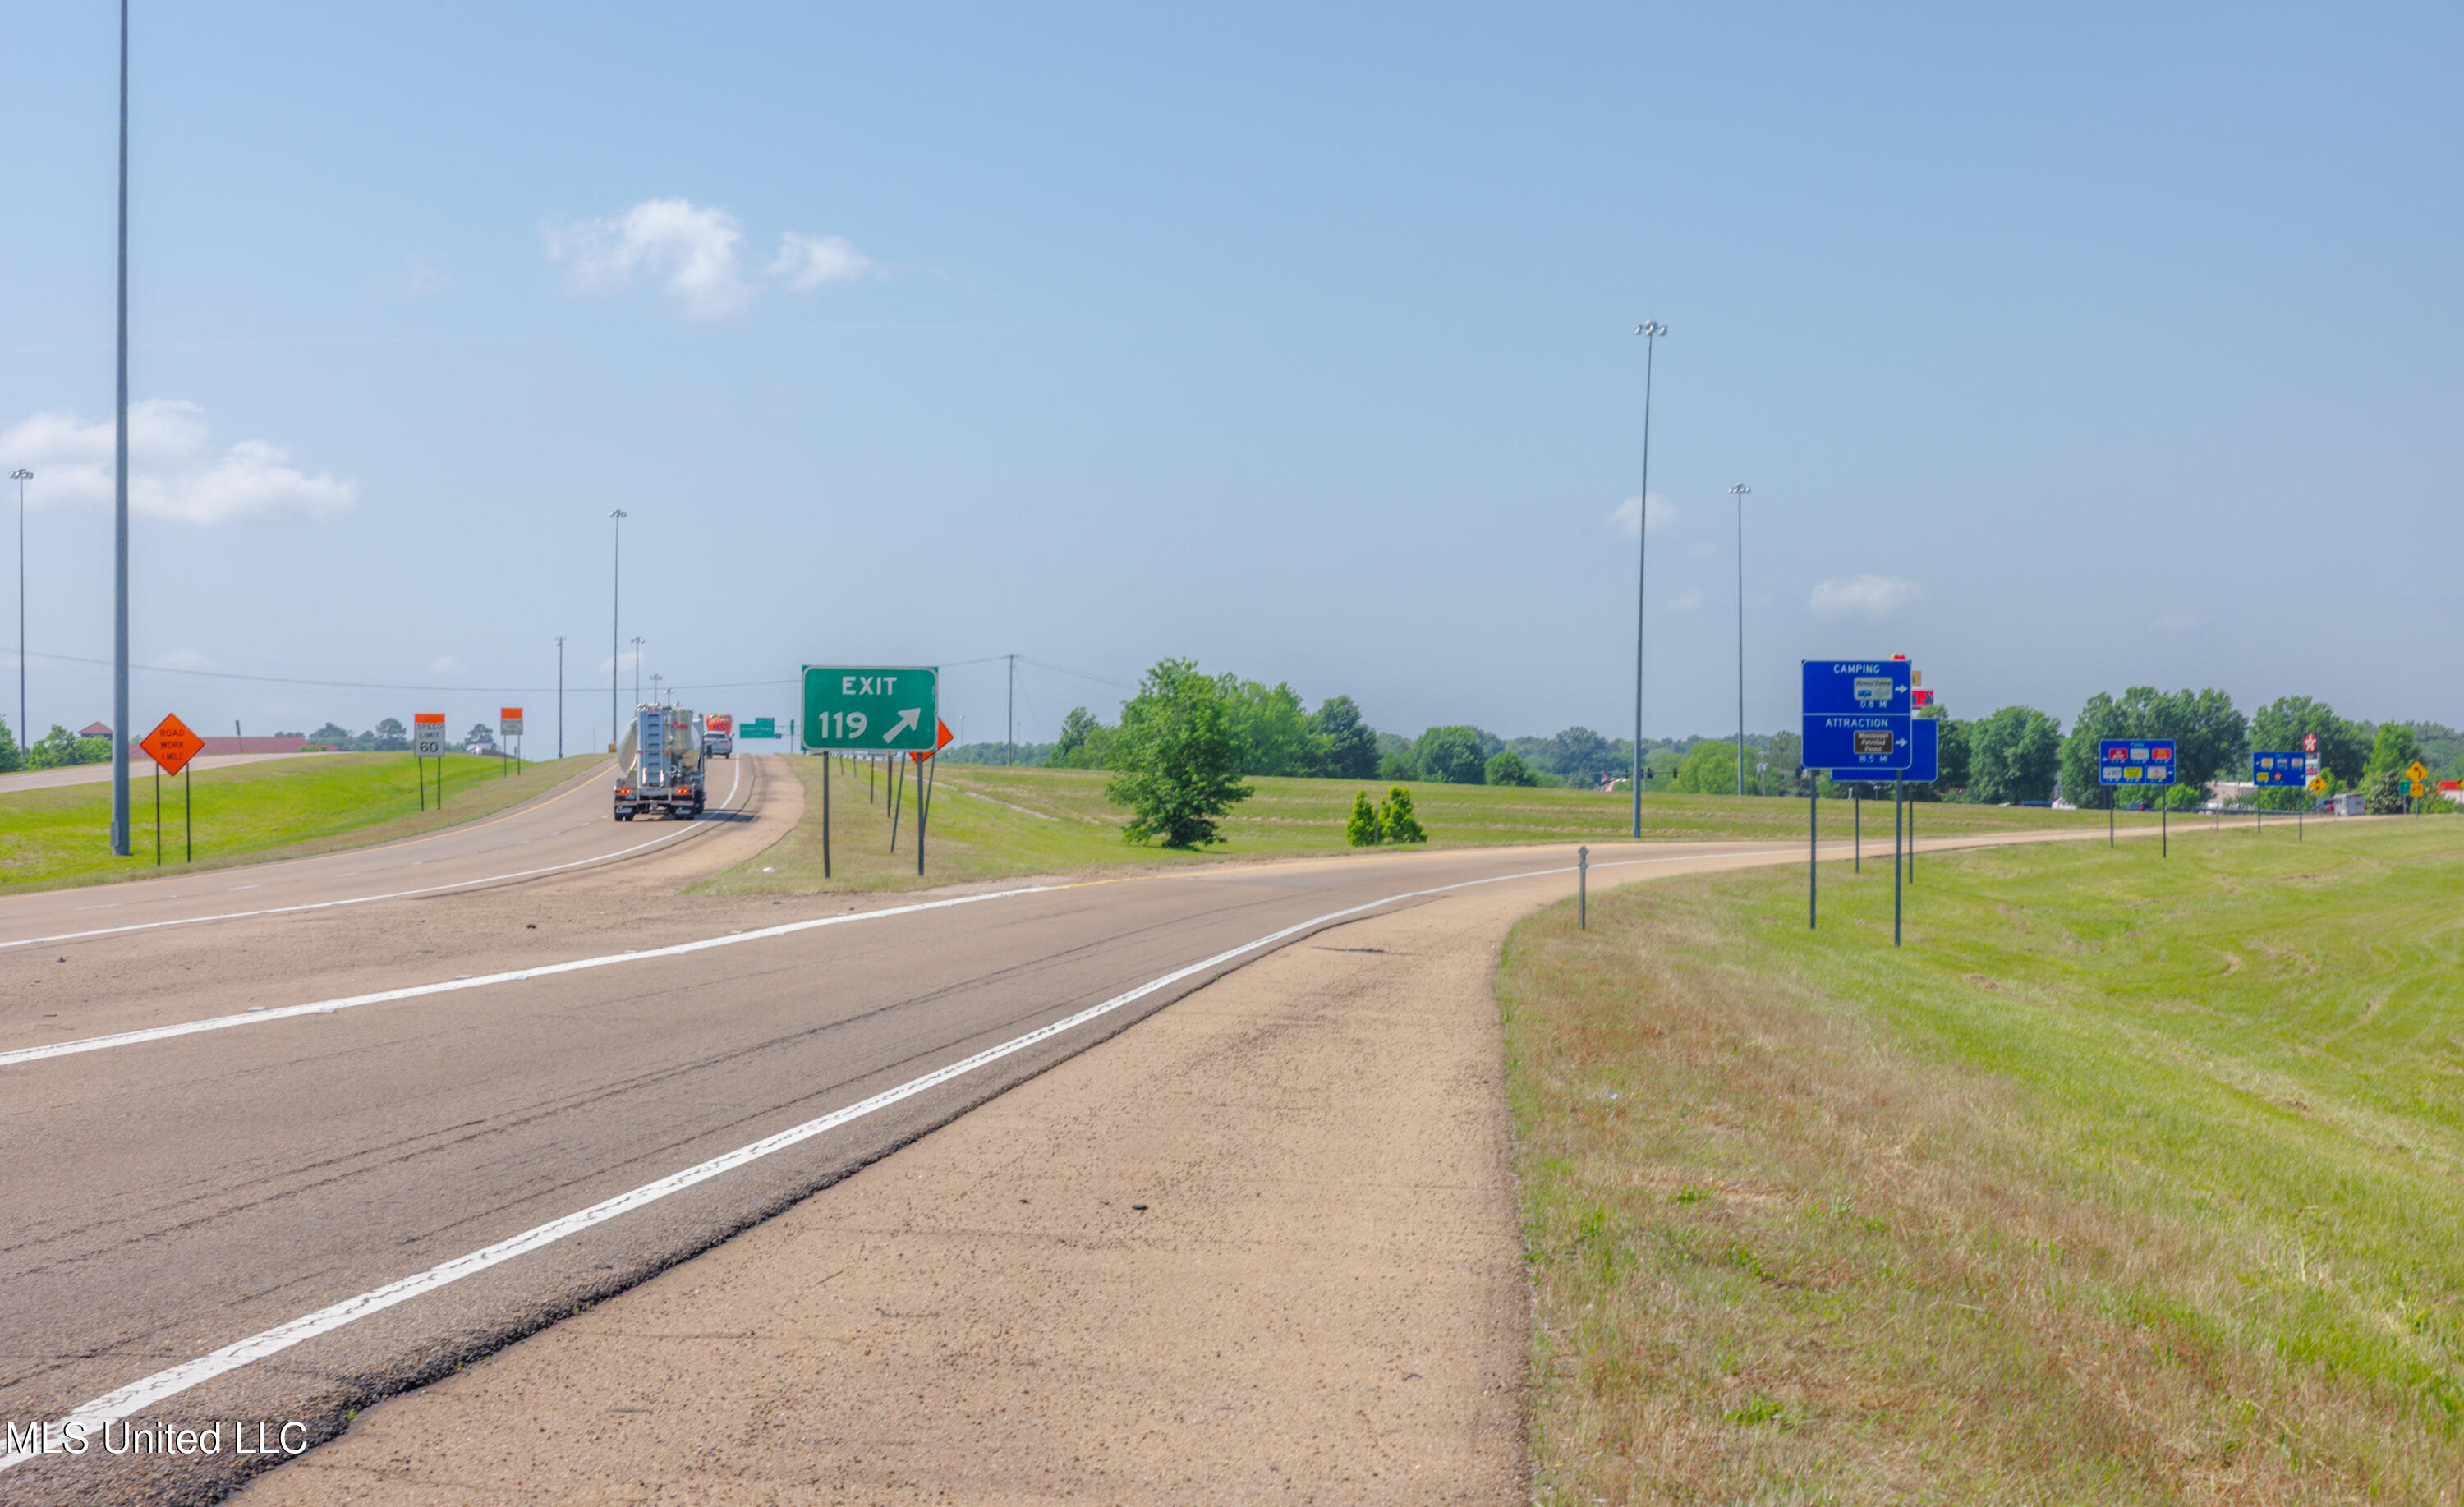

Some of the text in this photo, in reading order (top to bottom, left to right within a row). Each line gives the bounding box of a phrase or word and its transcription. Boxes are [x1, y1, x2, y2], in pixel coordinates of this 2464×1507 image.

[1833, 664, 1880, 673] CAMPING
[842, 676, 898, 696] EXIT
[819, 711, 868, 739] 119
[1825, 718, 1889, 728] ATTRACTION
[160, 741, 185, 749] WORK
[420, 741, 439, 753] 60
